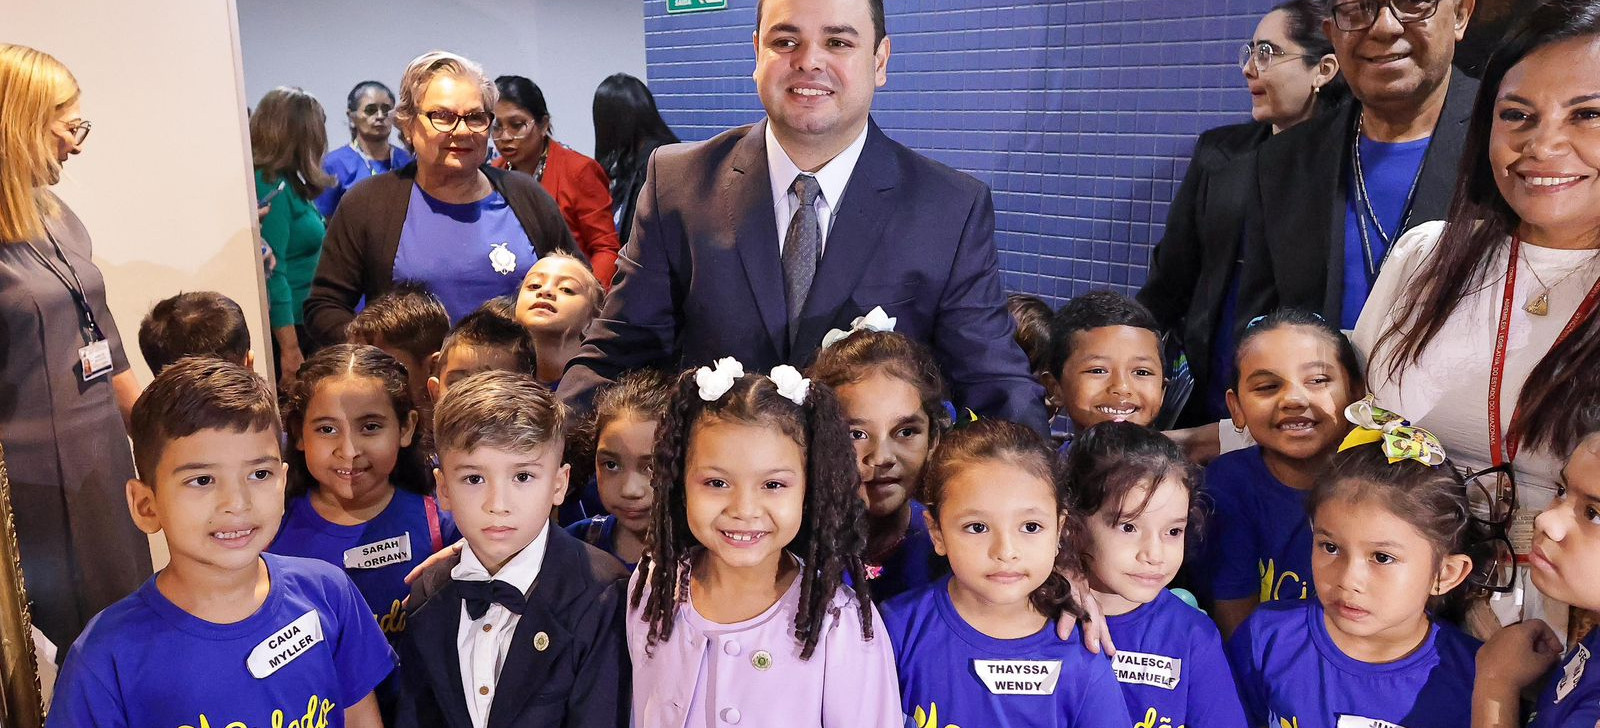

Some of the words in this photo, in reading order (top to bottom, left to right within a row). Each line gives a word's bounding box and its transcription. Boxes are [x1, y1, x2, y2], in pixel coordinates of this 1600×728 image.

[1489, 377, 1498, 399] ESTADO
[362, 540, 399, 556] SARAH
[268, 625, 301, 650] CAUA
[268, 634, 314, 668] MYLLER
[987, 664, 1049, 675] THAYSSA
[1117, 654, 1173, 671] VALESCA
[994, 681, 1042, 691] WENDY
